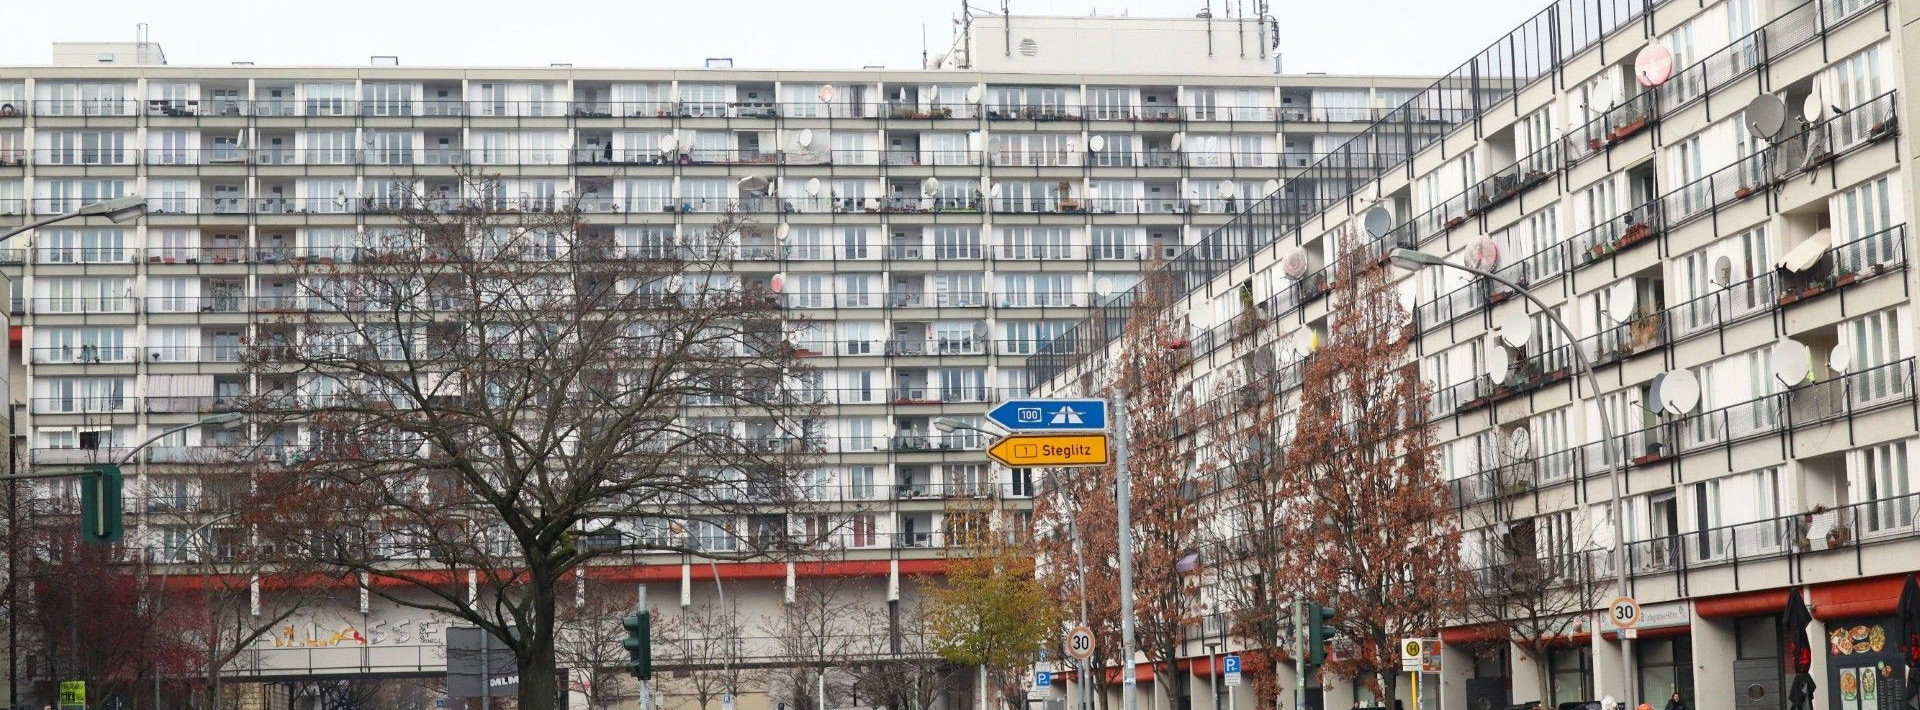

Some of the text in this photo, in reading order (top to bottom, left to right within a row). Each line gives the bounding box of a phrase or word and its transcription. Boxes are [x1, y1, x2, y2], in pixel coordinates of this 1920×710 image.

[1022, 410, 1038, 420] 100
[1043, 444, 1091, 458] Steglitz
[1616, 605, 1633, 619] 30
[1073, 635, 1089, 650] 30
[1410, 645, 1416, 653] H
[1226, 658, 1236, 671] P
[1038, 673, 1046, 684] P
